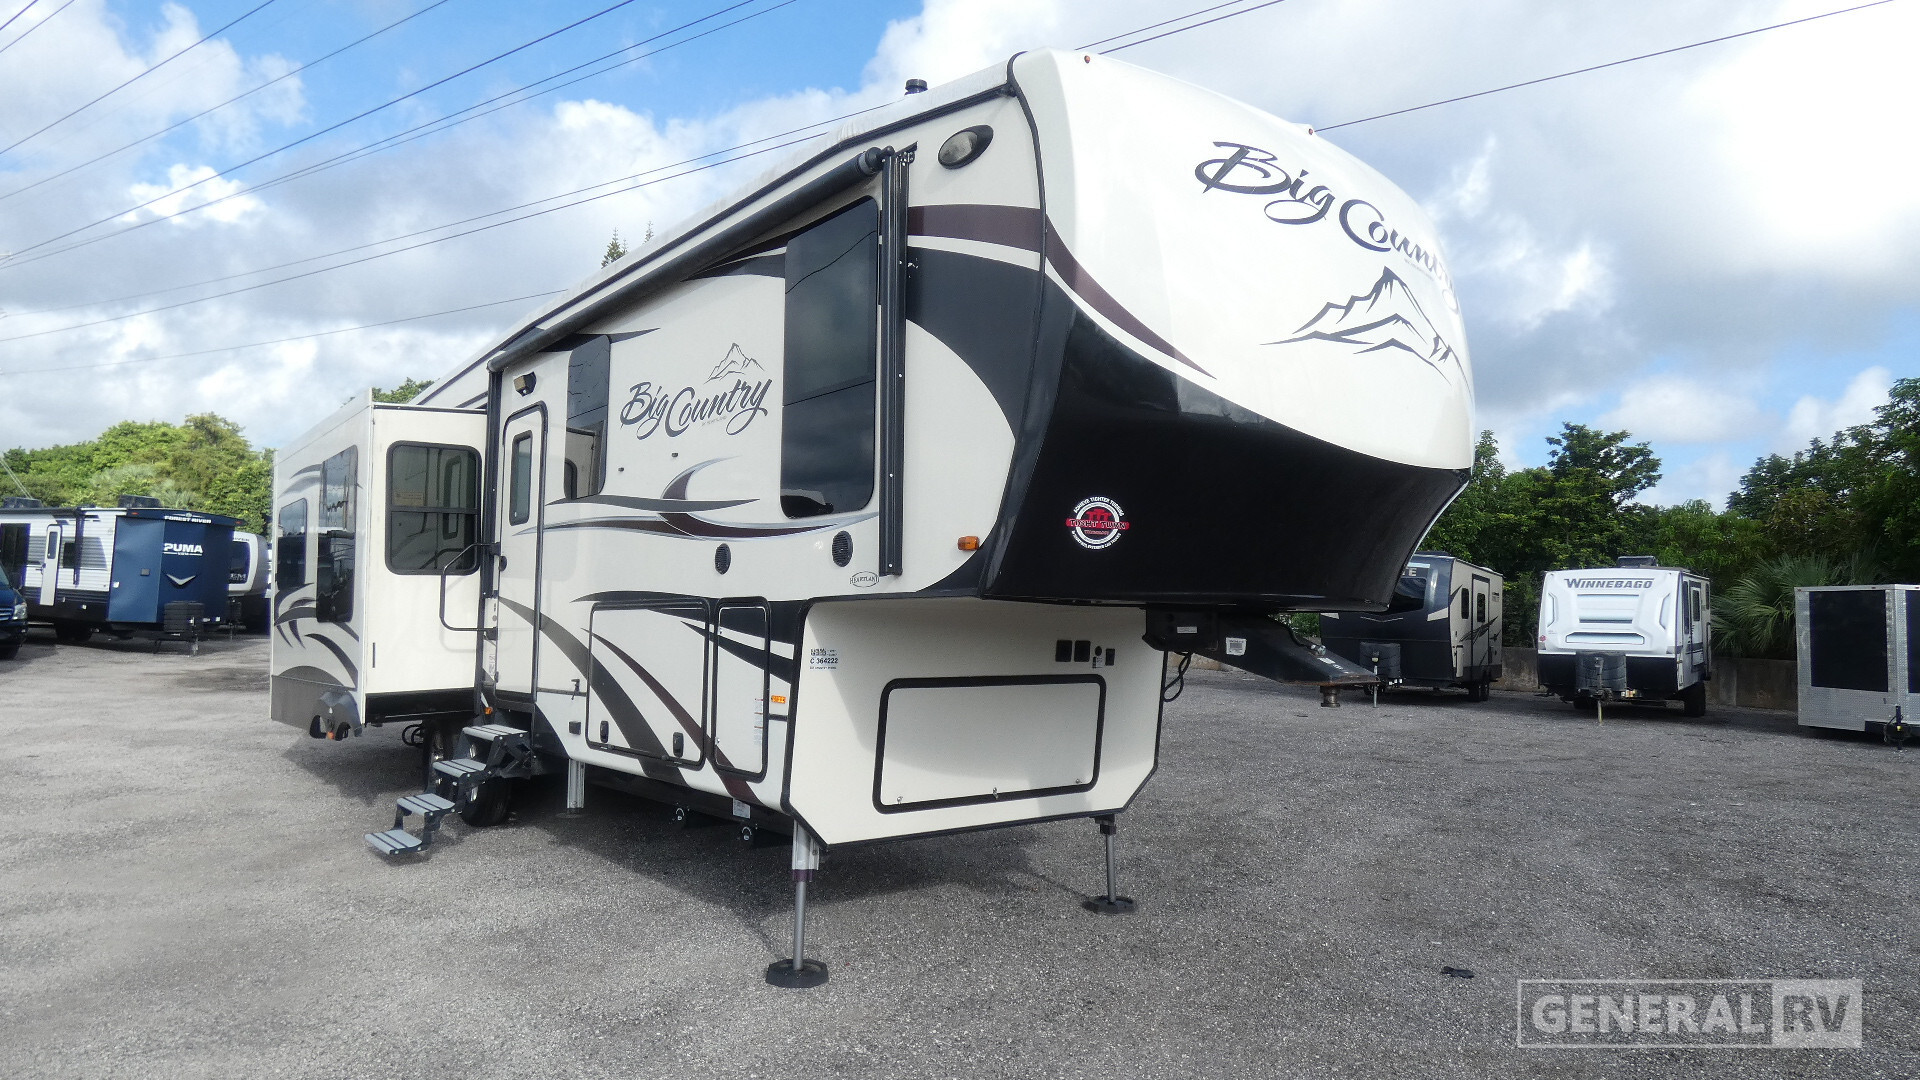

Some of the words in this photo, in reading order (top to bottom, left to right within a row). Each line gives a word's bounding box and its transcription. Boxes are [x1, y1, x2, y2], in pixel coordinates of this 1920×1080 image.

[1194, 141, 1335, 225] Big
[620, 381, 669, 441] Big
[665, 378, 773, 438] Country
[1069, 519, 1098, 528] TIGHT
[1100, 521, 1127, 530] TURN
[163, 542, 204, 553] PUMA
[849, 575, 880, 584] HEARTLAND
[1564, 577, 1655, 589] WINNEBAGO
